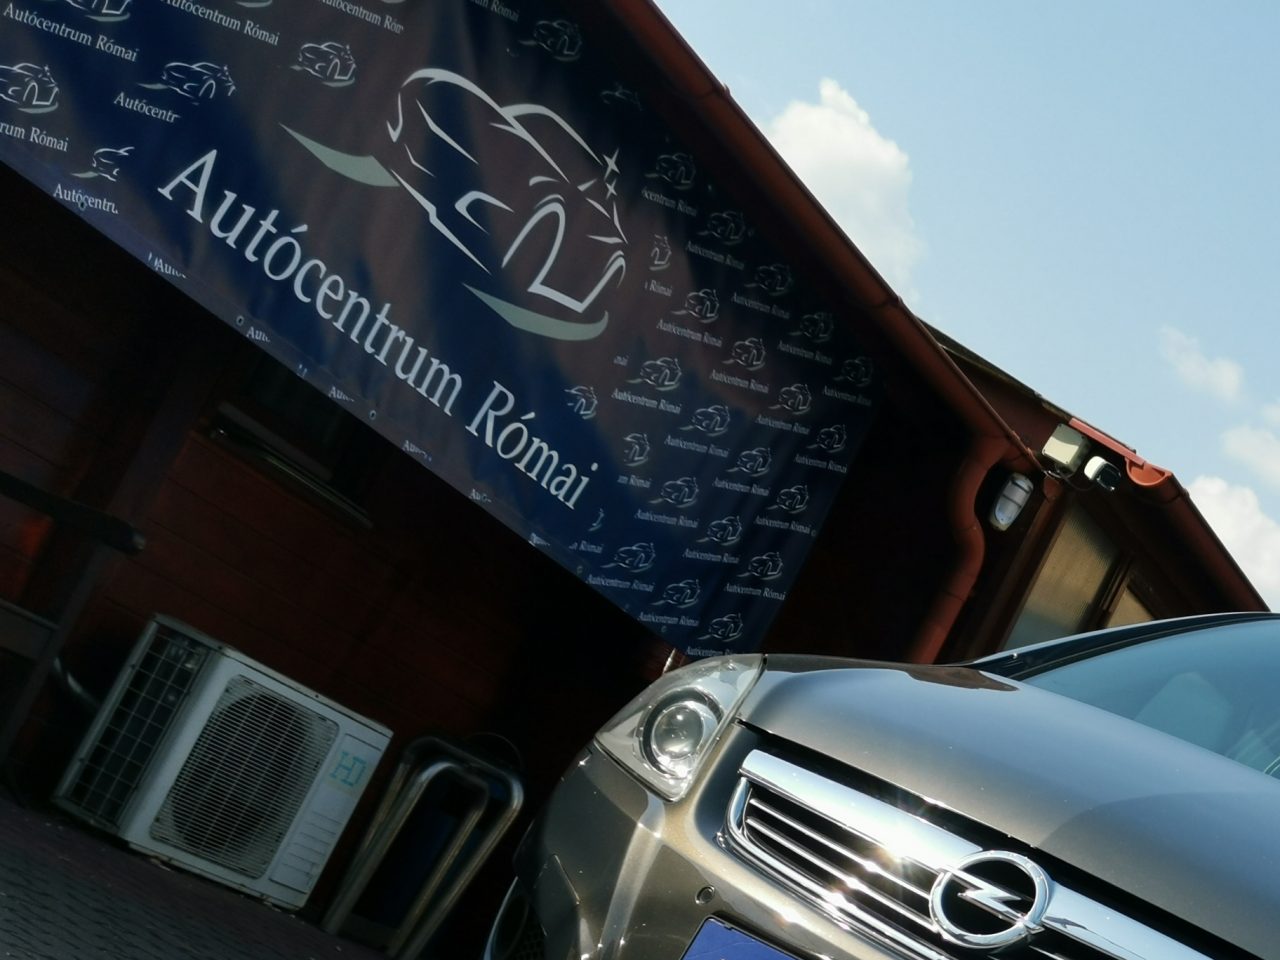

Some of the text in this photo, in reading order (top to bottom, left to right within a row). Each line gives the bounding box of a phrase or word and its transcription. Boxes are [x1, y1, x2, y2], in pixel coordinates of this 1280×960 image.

[3, 2, 140, 62] Autócentrum Római
[244, 20, 280, 46] Római
[29, 125, 70, 153] Római
[158, 149, 600, 510] Autócentrum Római
[656, 317, 703, 343] Autócentrum
[611, 387, 682, 415] Autócentrum Római
[664, 434, 708, 454] Autócentrum
[634, 508, 678, 526] Autócentrum
[762, 587, 787, 601] Római
